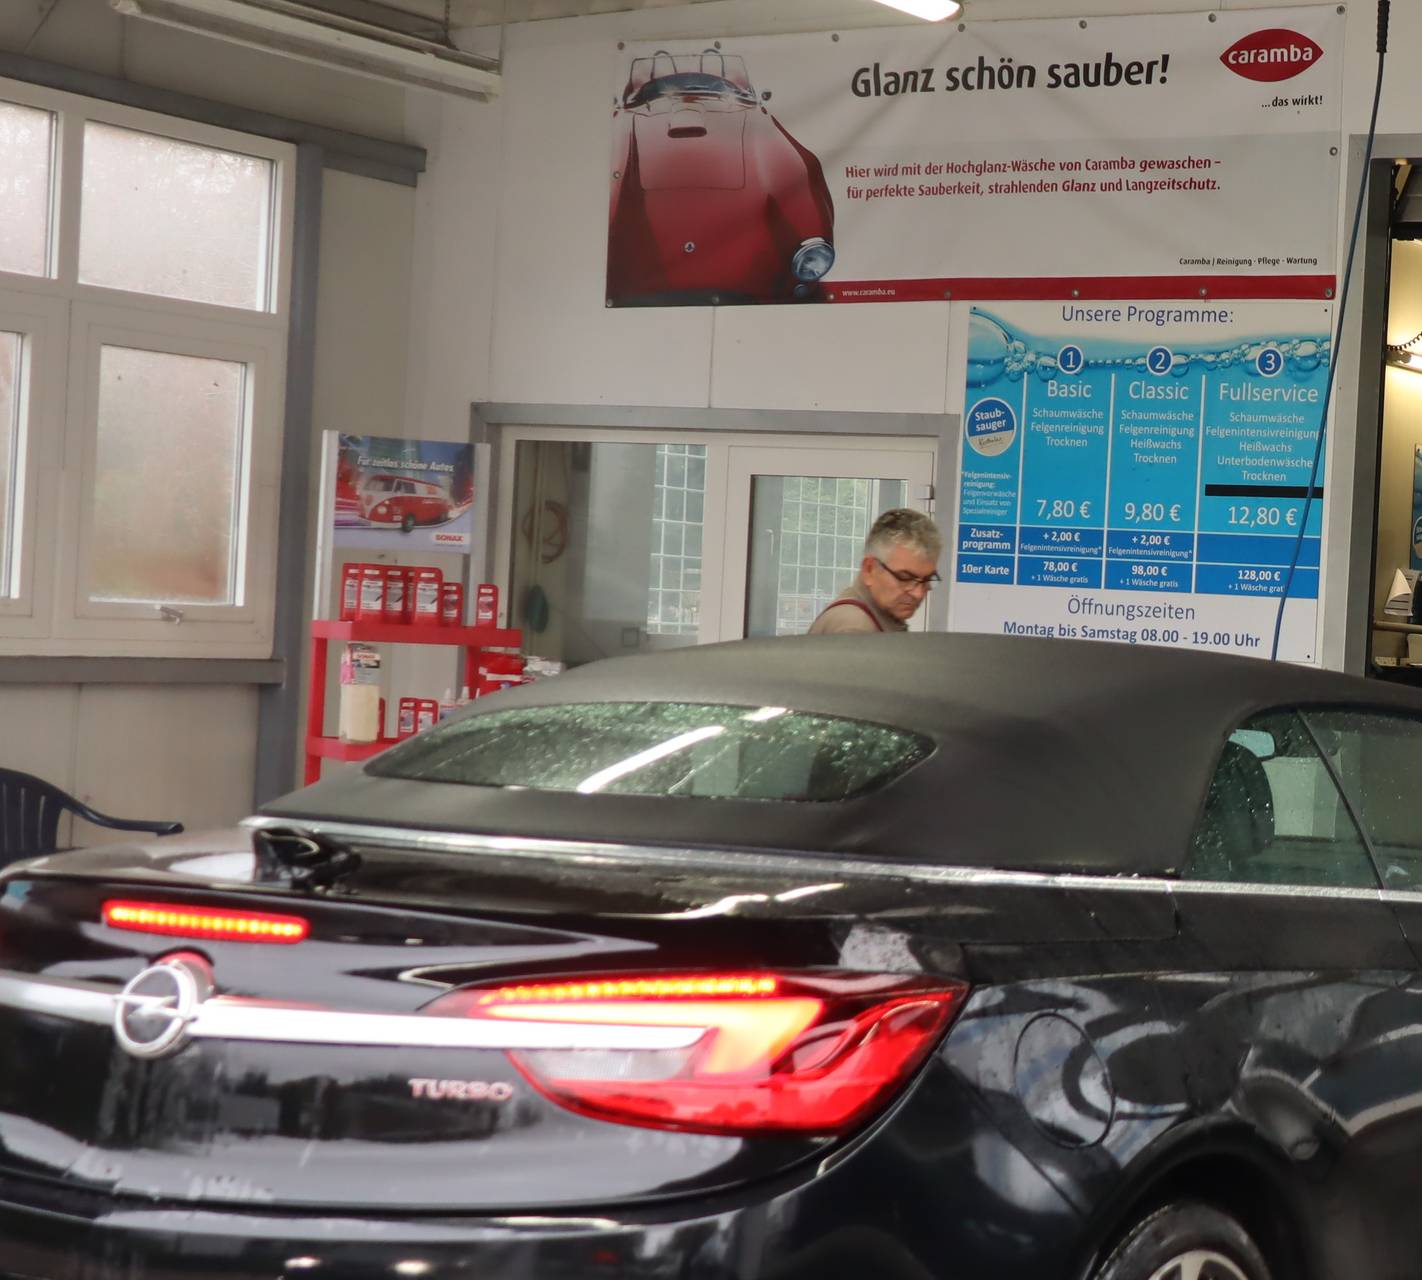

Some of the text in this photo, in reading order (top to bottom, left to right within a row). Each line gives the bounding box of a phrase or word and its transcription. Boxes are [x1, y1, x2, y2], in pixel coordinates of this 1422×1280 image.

[1228, 44, 1313, 64] caramba
[851, 52, 1170, 97] Glanz schön sauber!
[1291, 95, 1323, 106] wirkt!
[845, 165, 870, 178] Hier
[873, 163, 899, 177] wird
[901, 163, 921, 176] mit
[924, 162, 943, 175] der
[946, 158, 1055, 176] Hochglanz-Wäsche
[1059, 161, 1081, 171] von
[1085, 156, 1136, 170] Caramba
[1139, 156, 1211, 172] gewaschen
[846, 177, 1221, 200] für perfekte Sauberkeit, strahlenden Glanz und Langzeitschutz.
[1179, 257, 1211, 265] Caramba
[1216, 257, 1252, 267] Reinigung
[1257, 257, 1280, 266] Pflege
[1286, 257, 1318, 266] Wartung
[842, 288, 896, 297] www.caramba.eu
[1062, 305, 1234, 326] Unsere Programme:
[1066, 351, 1075, 367] 1
[1156, 352, 1165, 368] 2
[1265, 354, 1275, 370] 3
[1047, 379, 1092, 398] Basic
[1129, 380, 1190, 400] Classic
[1219, 381, 1319, 402] Fullservice
[975, 408, 1005, 421] Staub-
[1032, 407, 1104, 419] Schaumwäsche
[1121, 409, 1194, 421] Schaumwäsche
[1229, 411, 1304, 424] Schaumwäsche
[975, 419, 1006, 431] sauger
[1031, 422, 1104, 435] Felgenreinigung
[1119, 424, 1194, 437] Felgenreinigung
[1046, 436, 1088, 447] Trocknen
[1130, 439, 1181, 450] Heißwachs
[1239, 441, 1292, 453] Heißwachs
[1133, 453, 1177, 464] Trocknen
[1217, 456, 1313, 469] Unterbodenwäsche
[1241, 470, 1287, 482] Trocknen
[1036, 499, 1091, 520] 7,80 €
[1124, 502, 1181, 523] 9,80 €
[1228, 506, 1298, 528] 12,80 €
[970, 528, 1004, 539] Zusatz-
[1051, 531, 1072, 543] 2,00
[1073, 532, 1081, 542] €
[962, 540, 1011, 551] programm
[1140, 535, 1162, 546] 2,00
[1163, 535, 1170, 545] €
[961, 563, 1010, 575] 10er Karte
[1043, 561, 1078, 573] 78,00 €
[1131, 565, 1168, 577] 98,00 €
[1042, 574, 1069, 583] Wäsche
[1069, 575, 1088, 584] gratis
[1237, 570, 1281, 582] 128,00 €
[1131, 578, 1158, 587] Wäsche
[1159, 579, 1178, 589] gratis
[1240, 583, 1268, 592] Wäsche
[1269, 585, 1285, 594] grat
[1067, 595, 1195, 621] Öffnungszeiten
[1003, 621, 1055, 638] Montag
[1058, 623, 1077, 638] bis
[1081, 625, 1137, 643] Samstag
[1140, 628, 1179, 643] 08.00
[1191, 631, 1230, 646] 19.00
[1234, 633, 1261, 648] Uhr
[407, 1077, 513, 1101] TURBO
